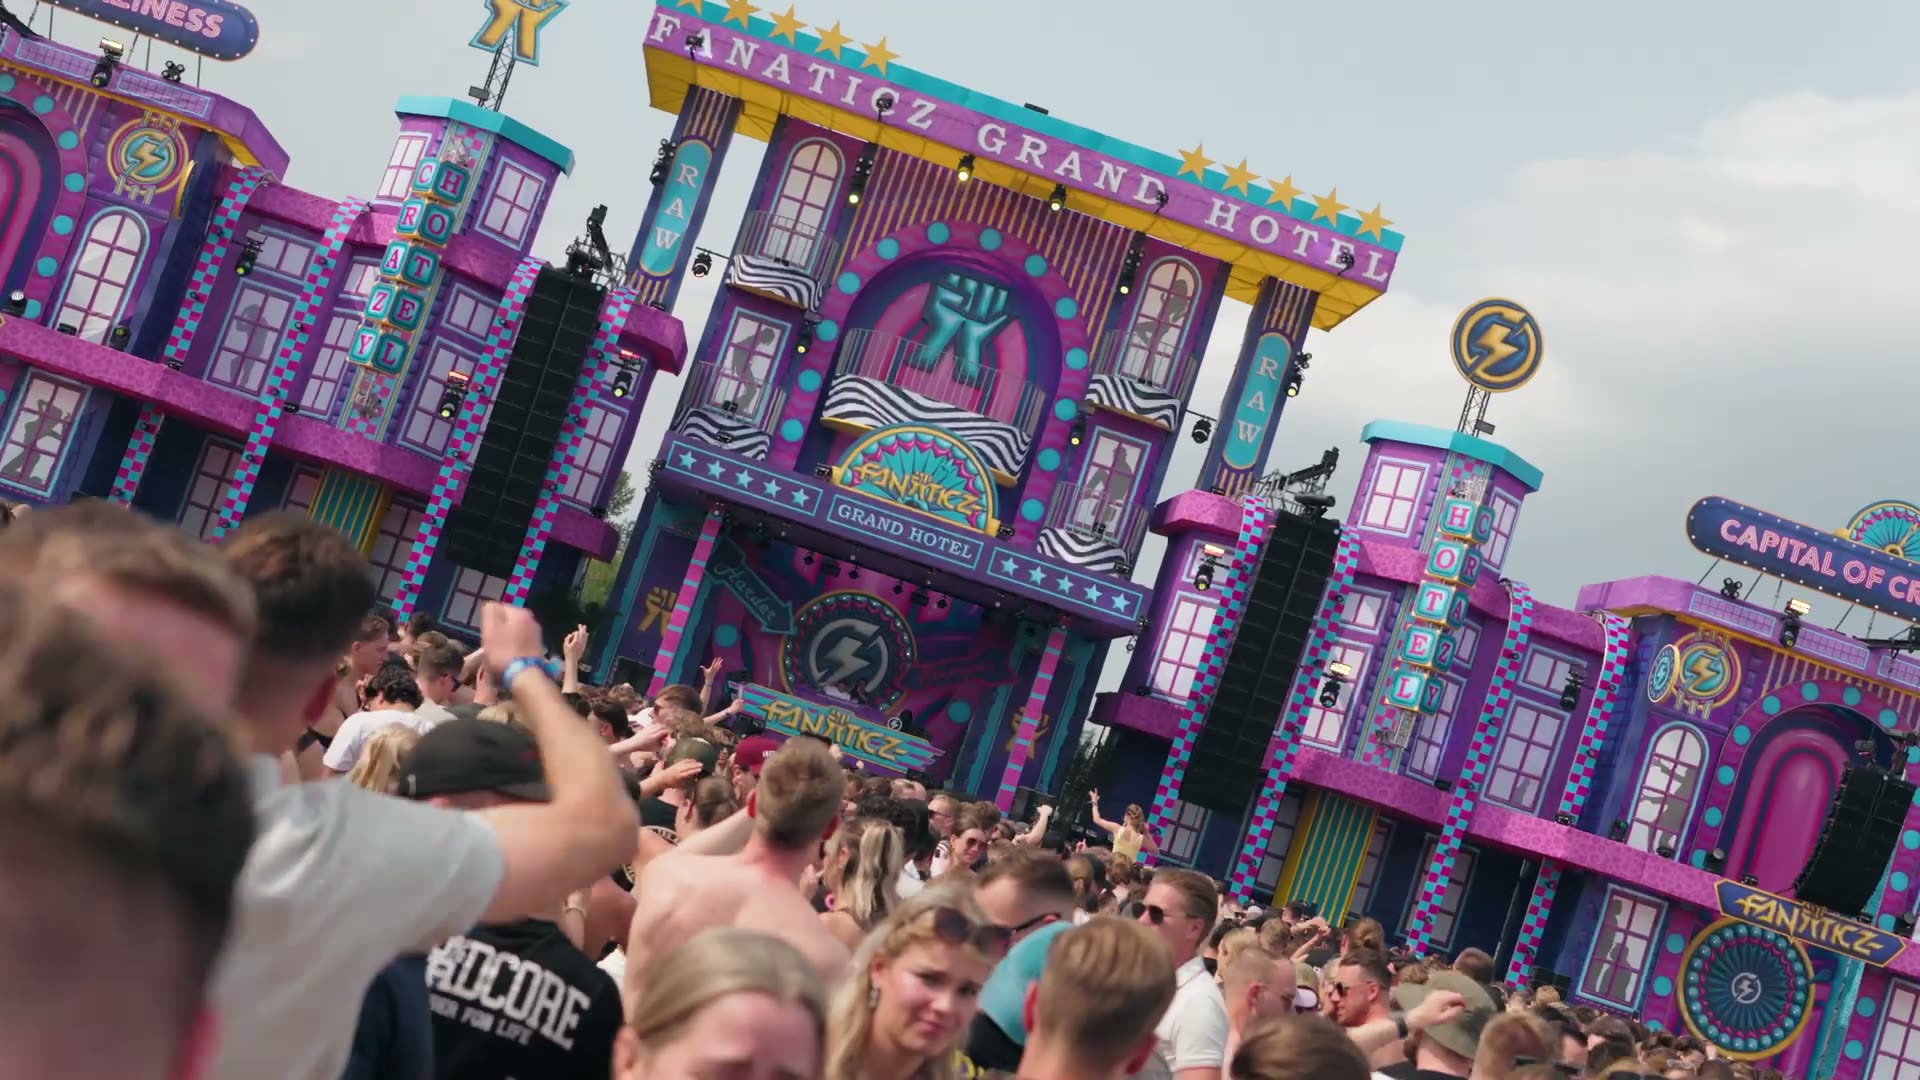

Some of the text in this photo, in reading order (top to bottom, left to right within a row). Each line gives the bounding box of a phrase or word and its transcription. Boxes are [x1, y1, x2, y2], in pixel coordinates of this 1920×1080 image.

[649, 12, 1389, 283] FANATICZ GRAND HOTEL
[655, 163, 699, 250] RAW
[1237, 356, 1279, 445] RAW
[854, 462, 984, 516] FANATICZ
[837, 503, 973, 560] GRAND HOTEL
[1720, 518, 1836, 578] CAPITAL
[1842, 559, 1887, 590] OF
